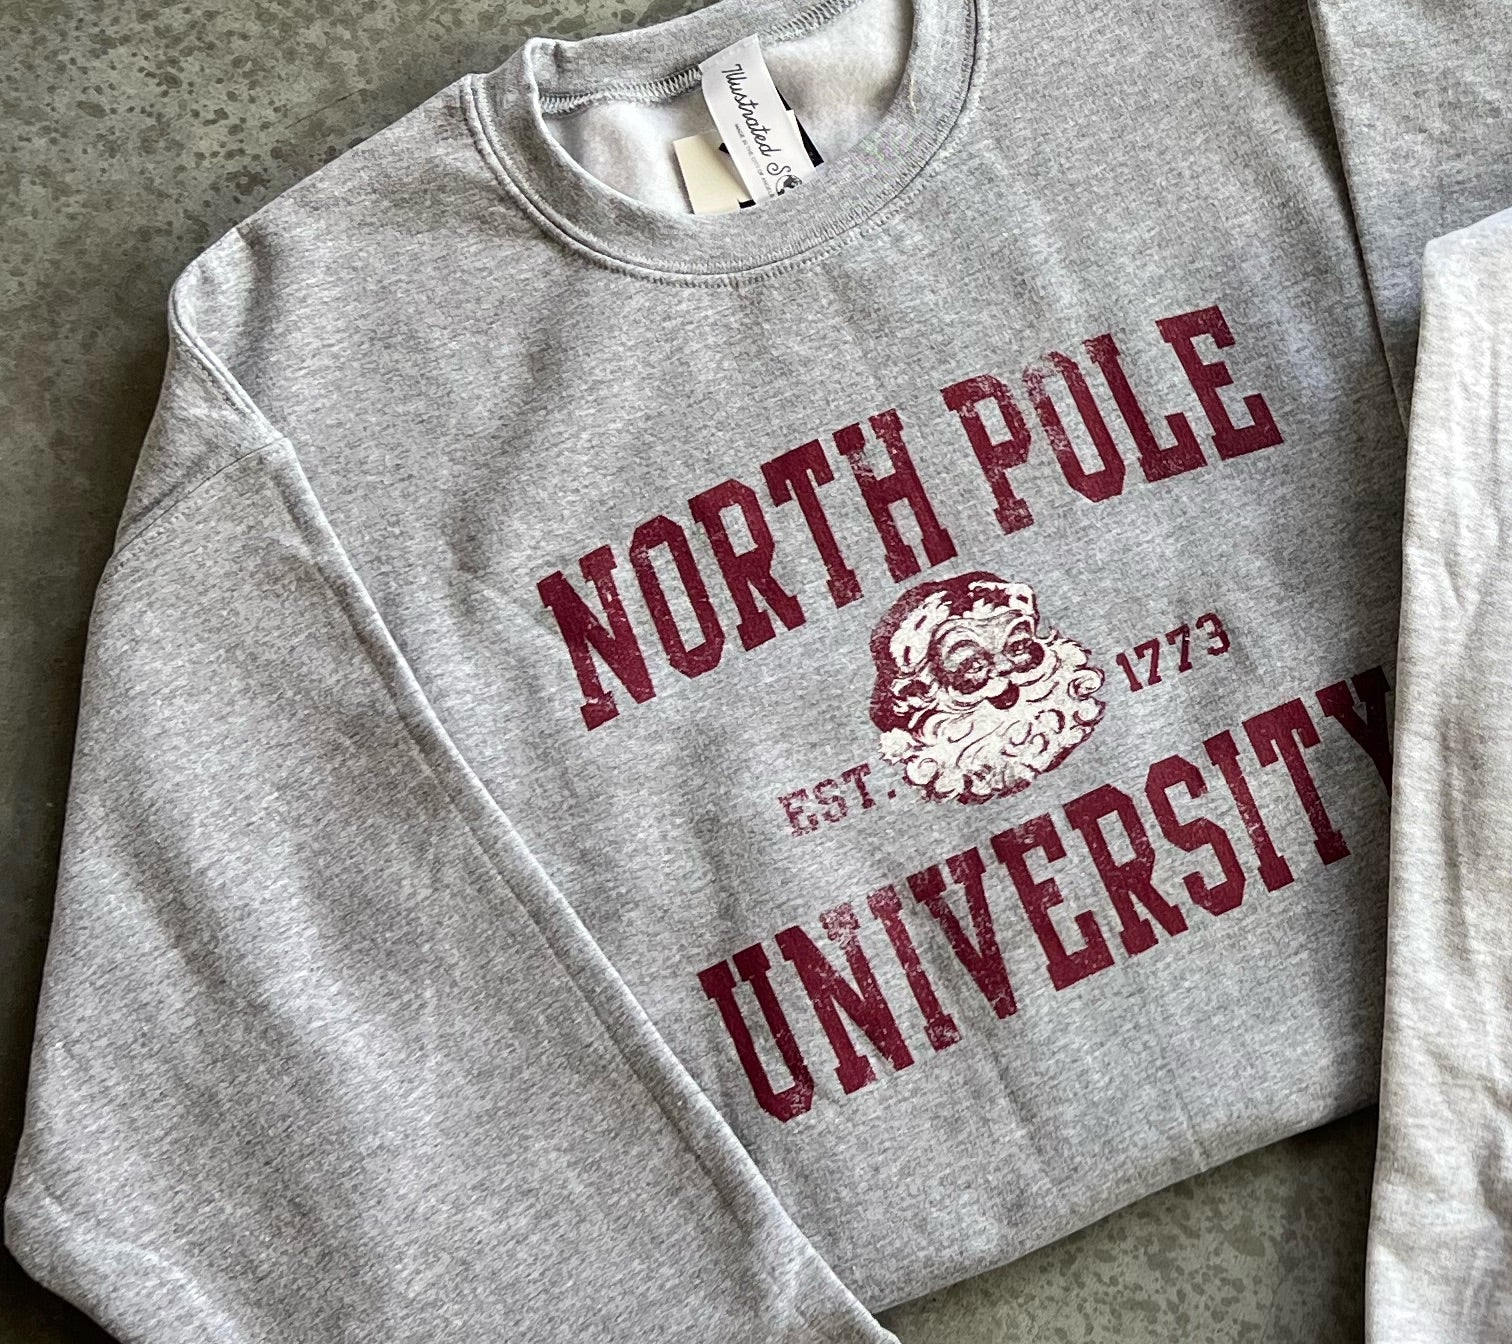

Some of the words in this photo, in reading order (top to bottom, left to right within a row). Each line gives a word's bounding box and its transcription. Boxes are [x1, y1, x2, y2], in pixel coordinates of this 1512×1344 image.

[721, 64, 782, 157] Illustrated
[536, 408, 958, 731] NORTH
[940, 305, 1284, 536] POLE
[777, 763, 896, 837] EST.
[1116, 613, 1231, 692] 1773
[697, 665, 1392, 1124] UNIVERSITY
